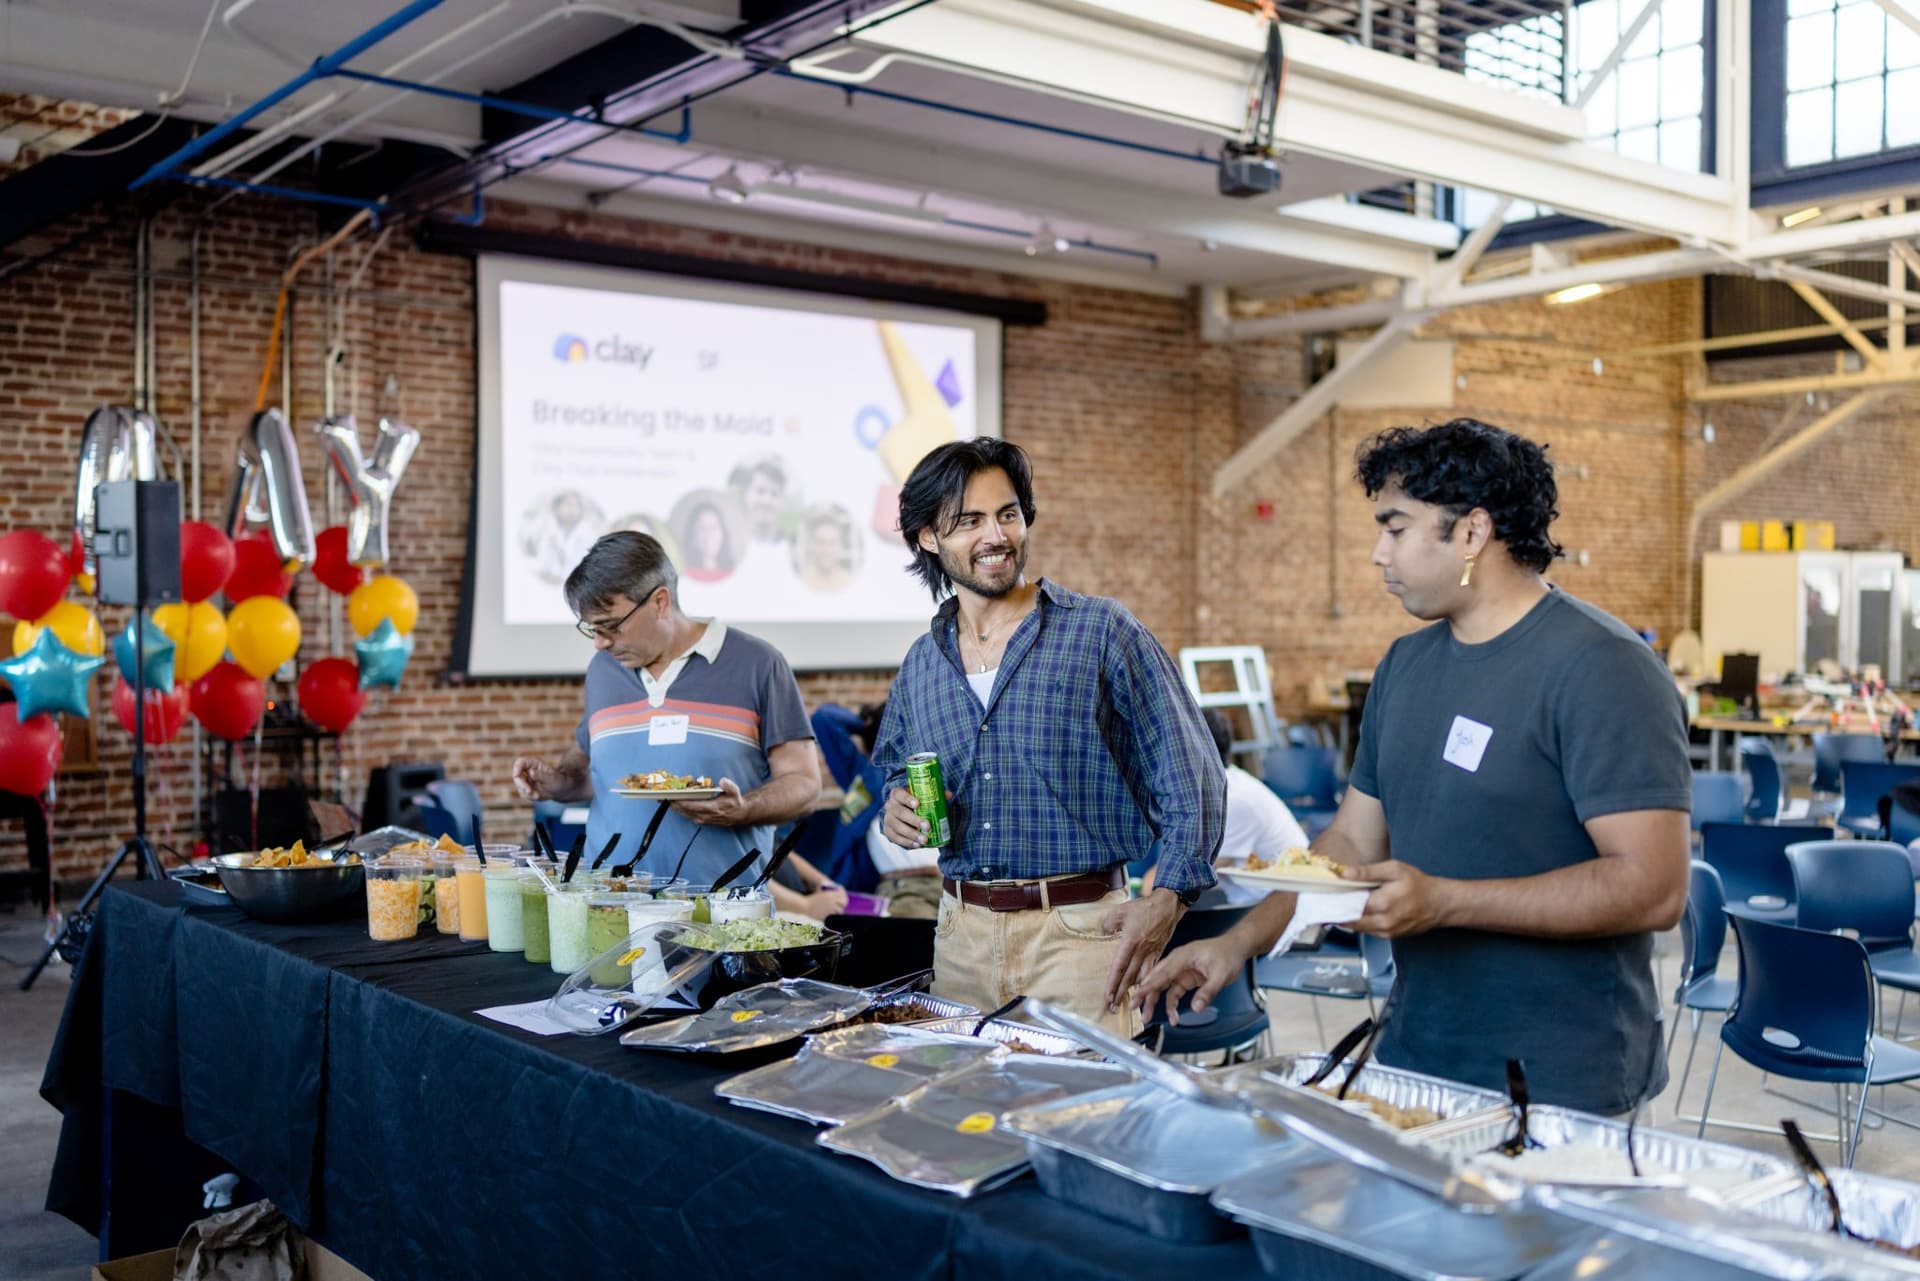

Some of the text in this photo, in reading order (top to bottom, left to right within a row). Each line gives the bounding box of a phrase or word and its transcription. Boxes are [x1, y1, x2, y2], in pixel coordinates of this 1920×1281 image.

[595, 332, 654, 371] clay
[532, 398, 656, 438] Breaking
[663, 407, 705, 431] the
